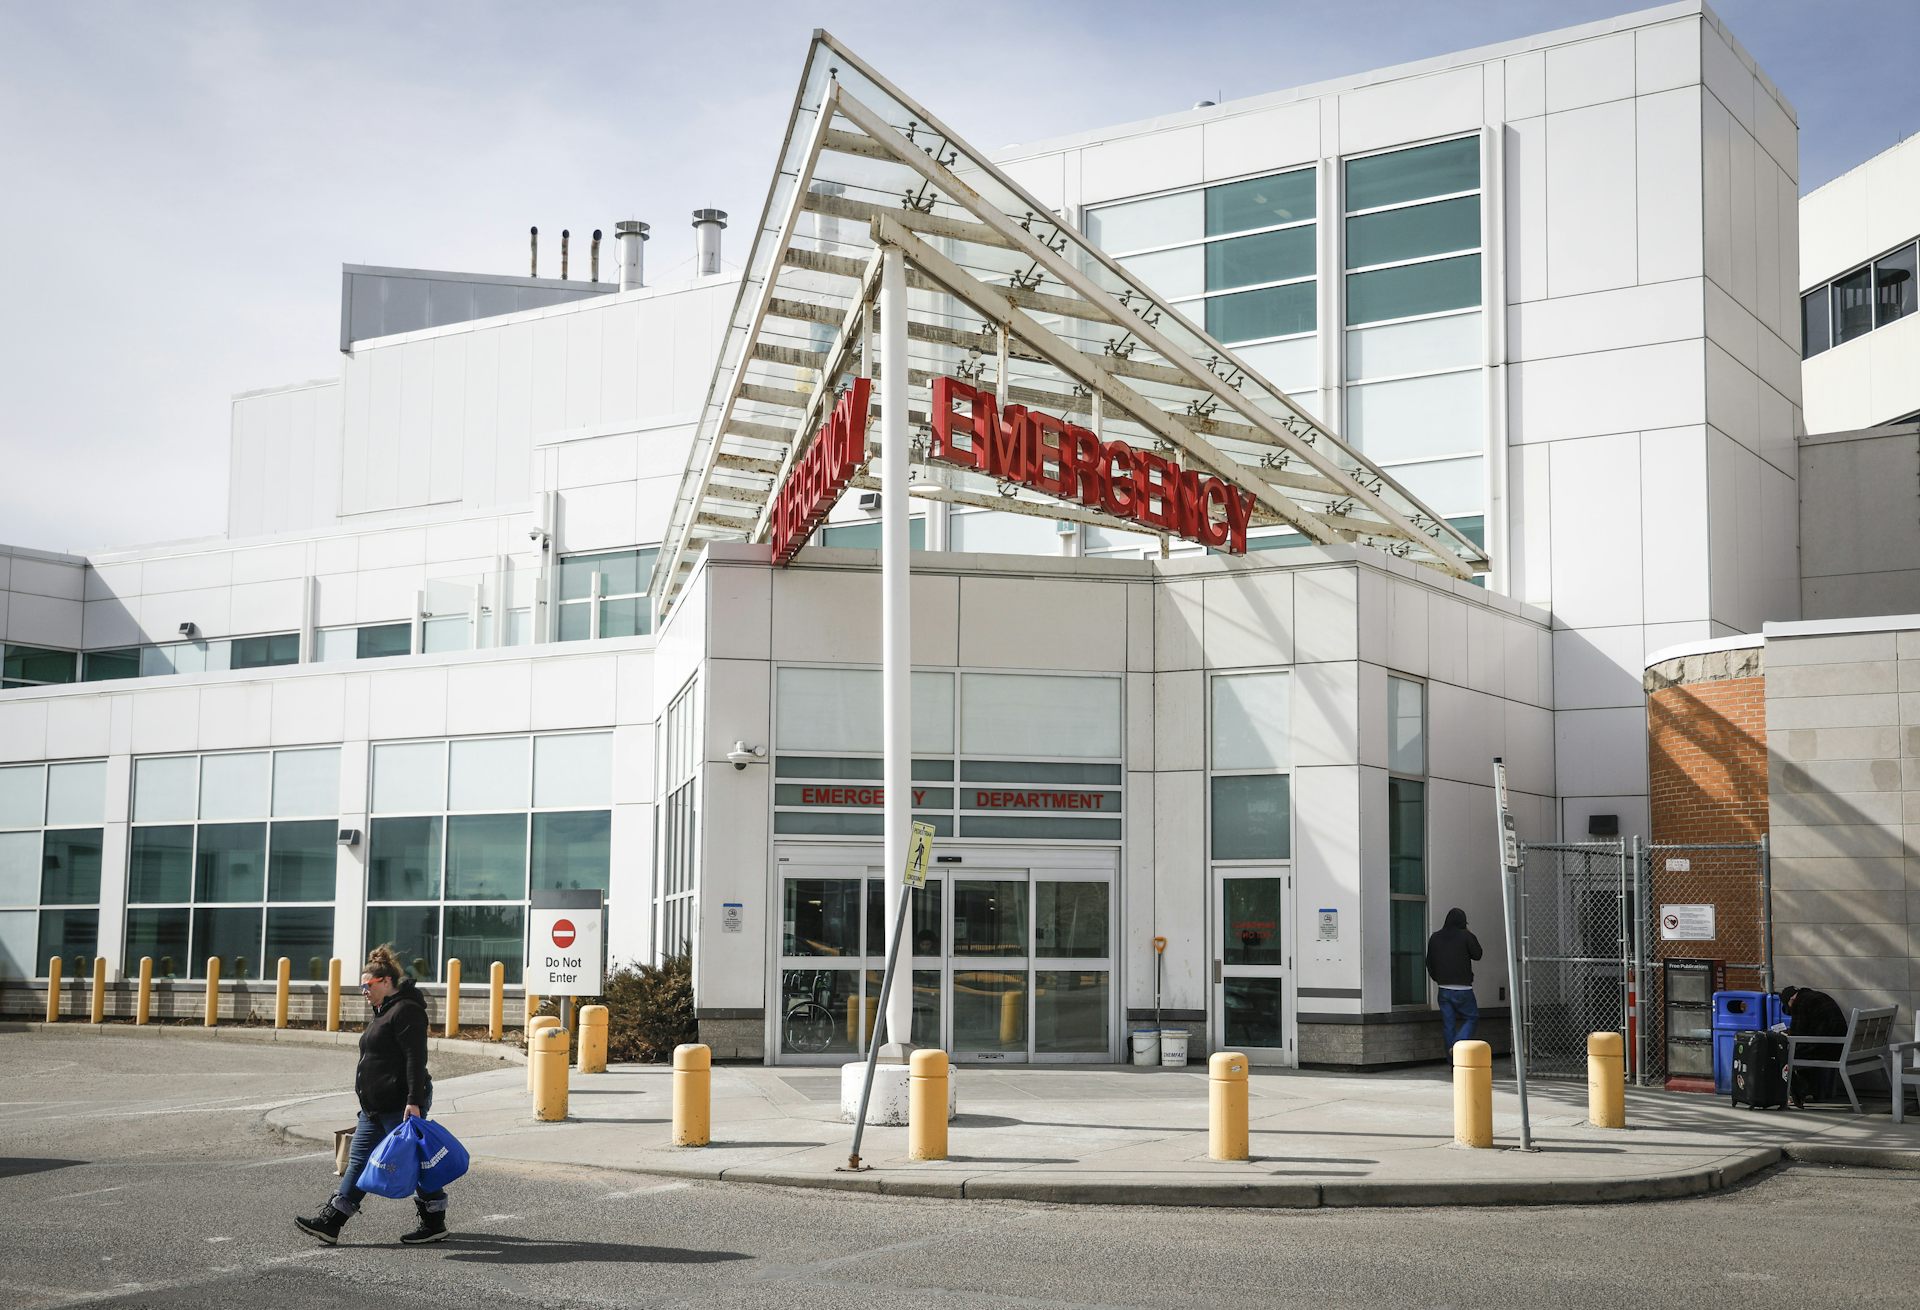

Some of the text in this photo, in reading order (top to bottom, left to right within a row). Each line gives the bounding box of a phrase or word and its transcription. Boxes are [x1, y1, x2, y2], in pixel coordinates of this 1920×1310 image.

[771, 377, 871, 566] EMERGENCY
[931, 376, 1257, 555] EMERGENCY
[802, 787, 1105, 809] EMERGEY DEPARTMENT
[545, 957, 582, 968] Do Not
[549, 972, 578, 983] Enter
